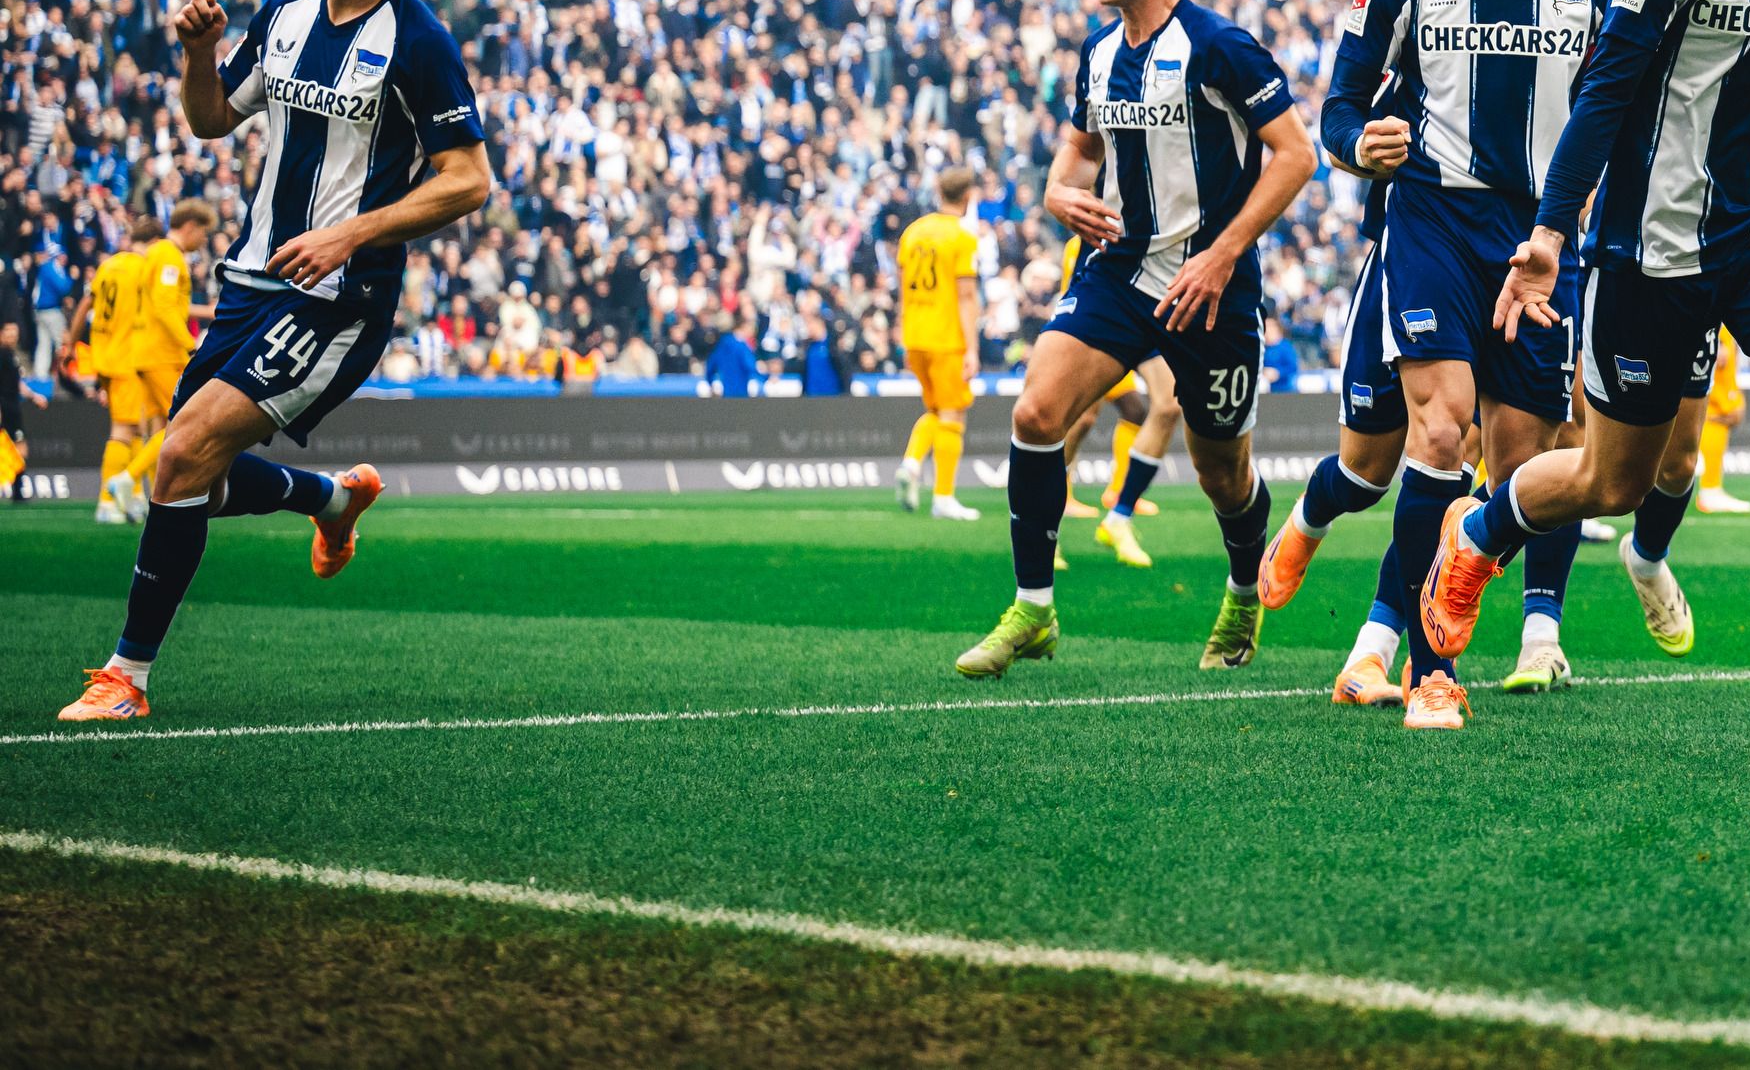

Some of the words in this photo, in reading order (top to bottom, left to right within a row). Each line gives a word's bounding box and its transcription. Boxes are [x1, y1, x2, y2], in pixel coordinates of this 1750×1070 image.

[1420, 24, 1585, 56] CHECKCARS24
[1095, 102, 1185, 127] ECKCARS24
[263, 313, 318, 378] 44
[1206, 364, 1249, 410] 30
[503, 466, 623, 492] CASTORE
[767, 461, 881, 488] CASTORE
